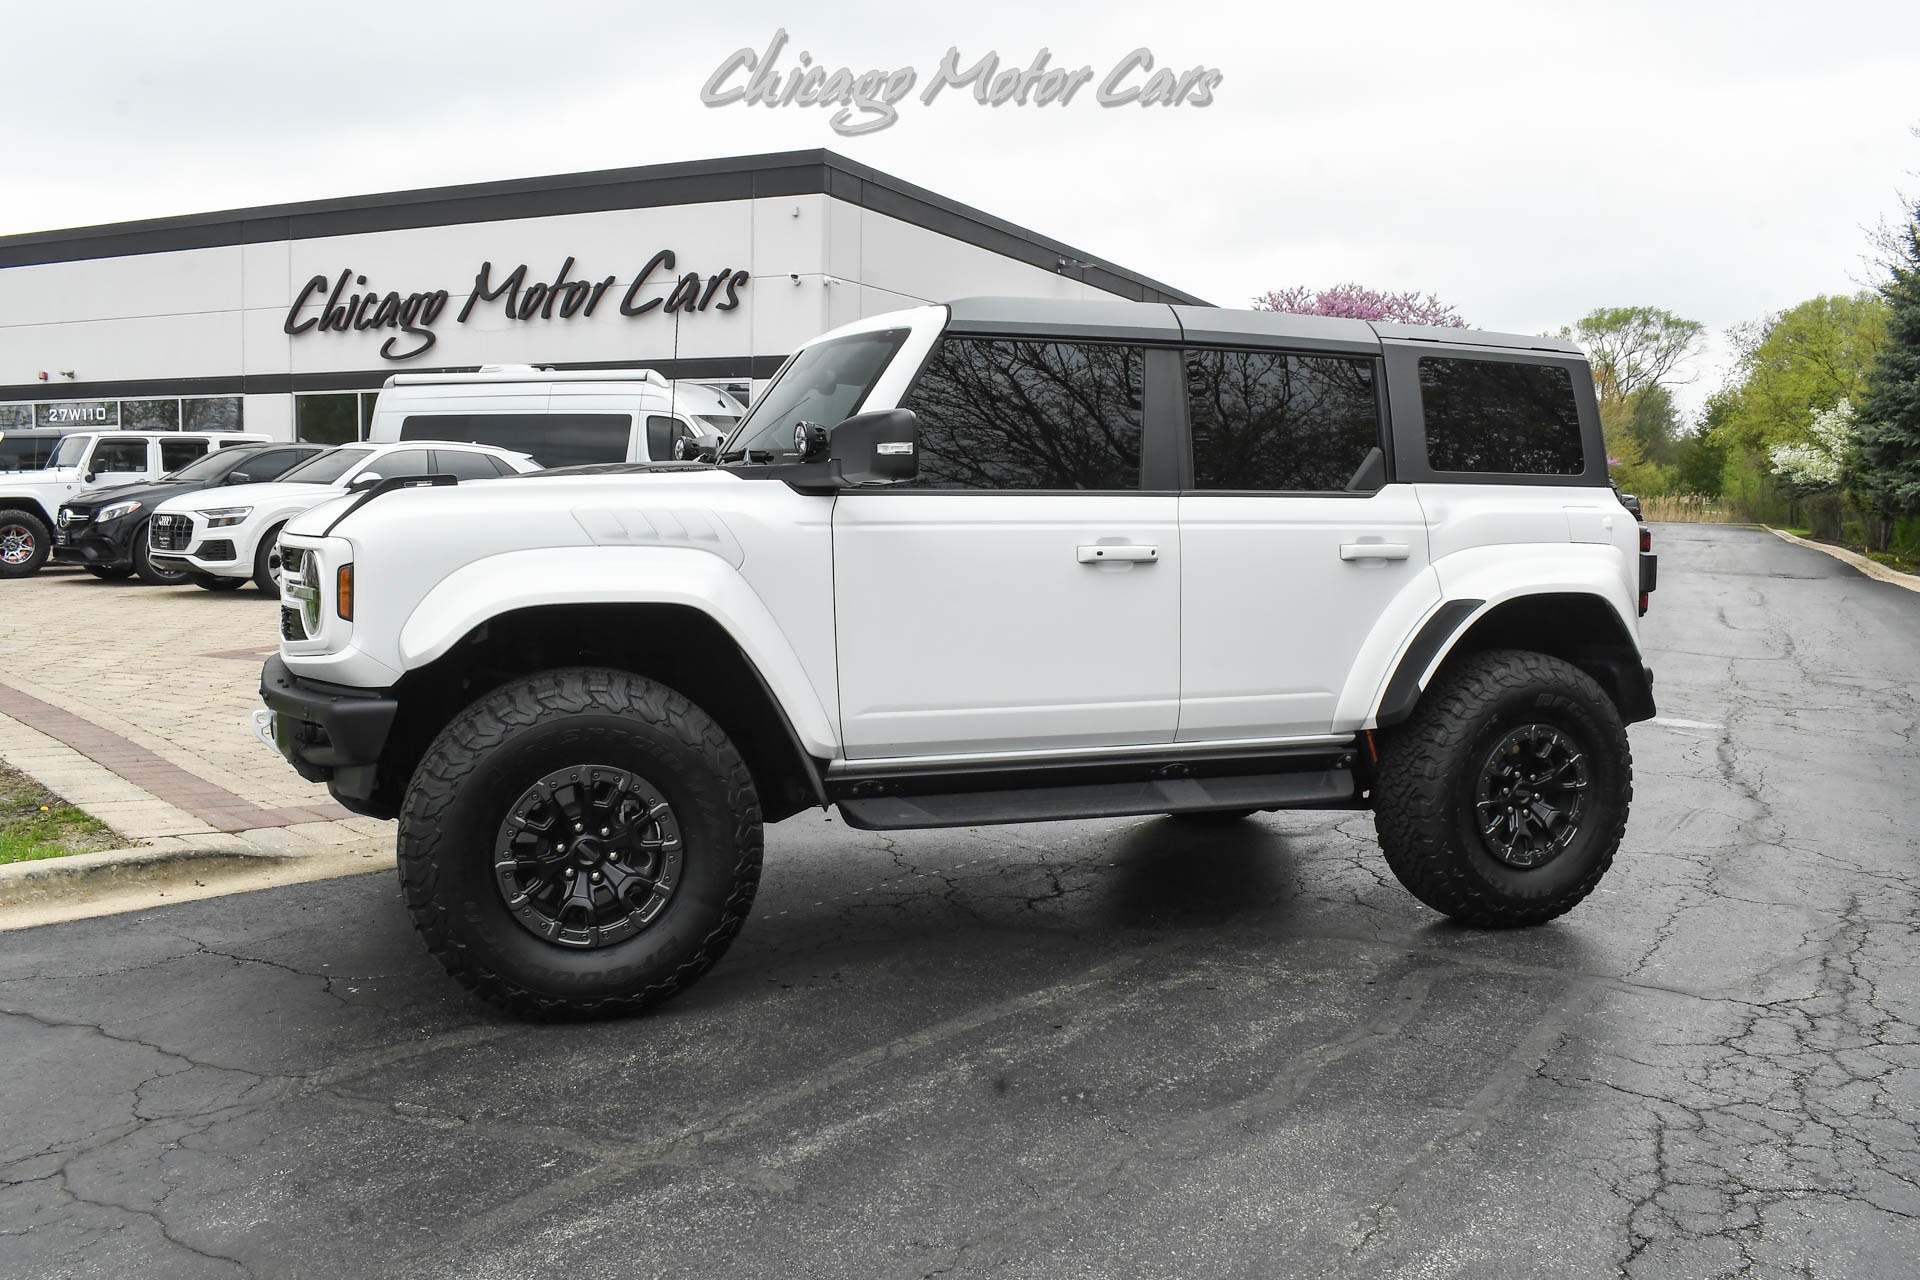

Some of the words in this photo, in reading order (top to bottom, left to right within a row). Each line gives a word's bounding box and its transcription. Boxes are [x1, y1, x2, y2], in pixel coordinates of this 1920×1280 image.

[283, 268, 449, 361] Chicago
[457, 256, 616, 324] Motor
[619, 249, 750, 317] Cars
[49, 407, 106, 422] 27W110
